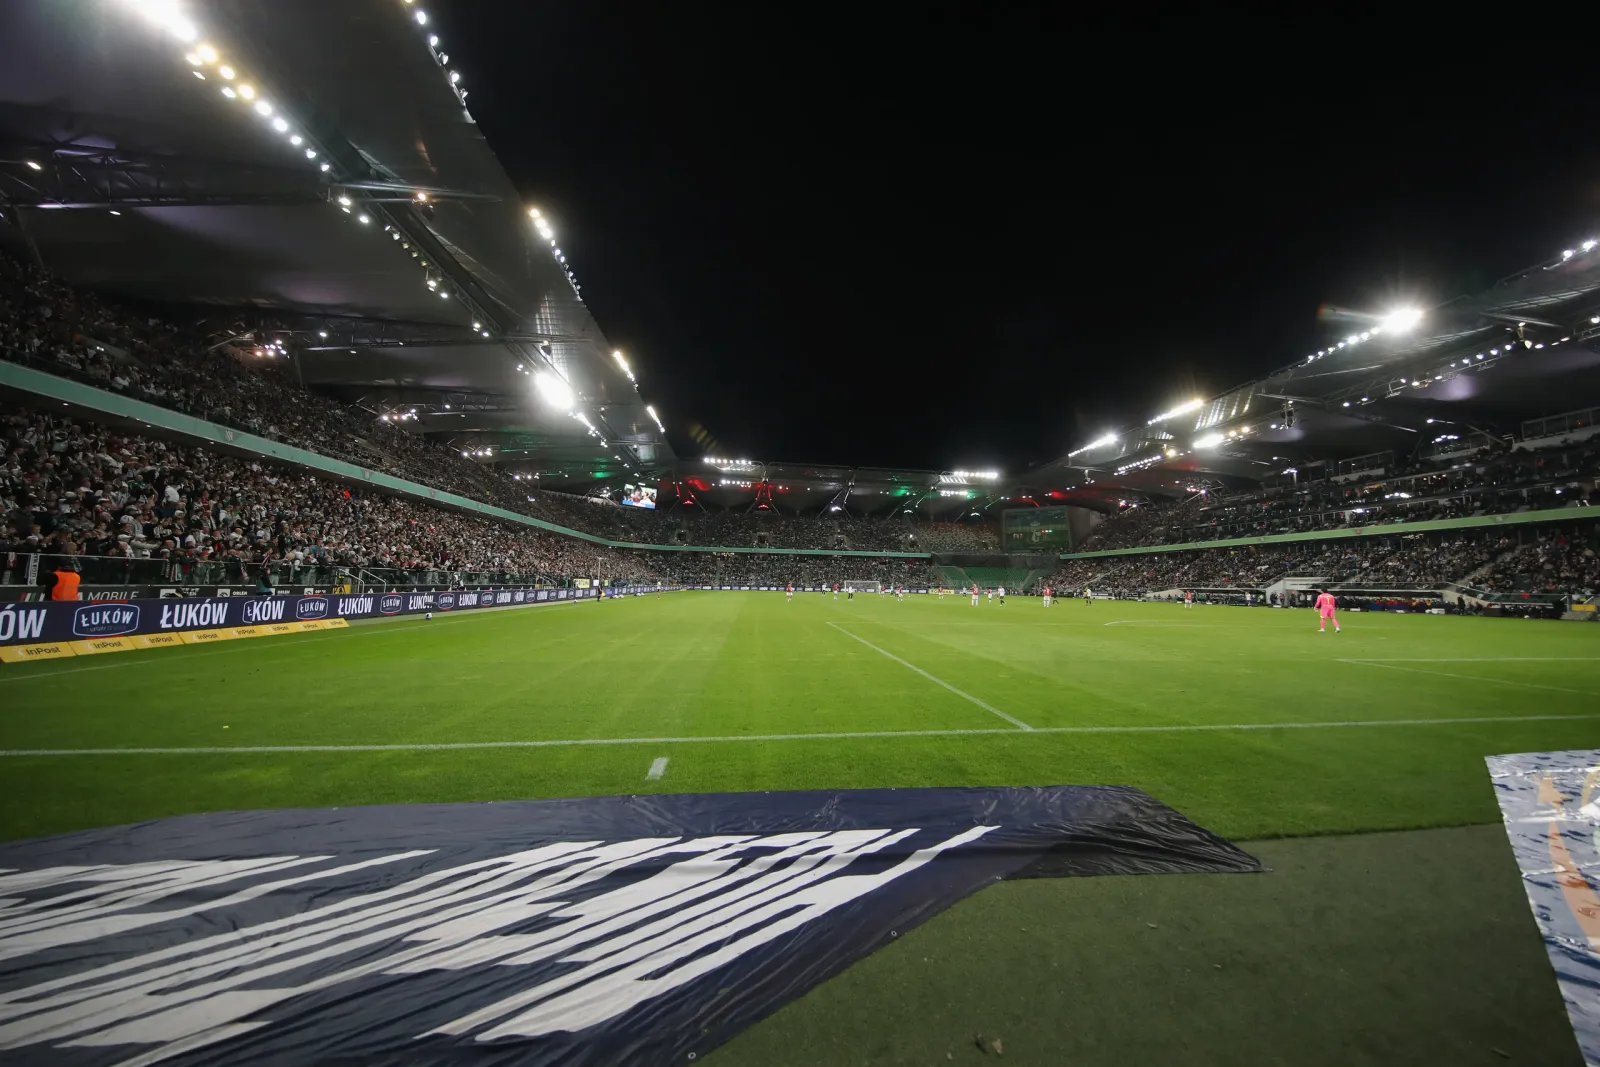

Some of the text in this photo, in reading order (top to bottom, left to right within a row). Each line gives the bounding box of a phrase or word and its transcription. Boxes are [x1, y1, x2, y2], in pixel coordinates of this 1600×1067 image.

[300, 601, 325, 613] ŁUKÓW
[338, 594, 373, 615] ŁUKÓW
[81, 608, 134, 628] ŁUKÓW
[160, 599, 228, 628] ŁUKÓW
[26, 646, 61, 655] InPost
[93, 641, 123, 649] InPost
